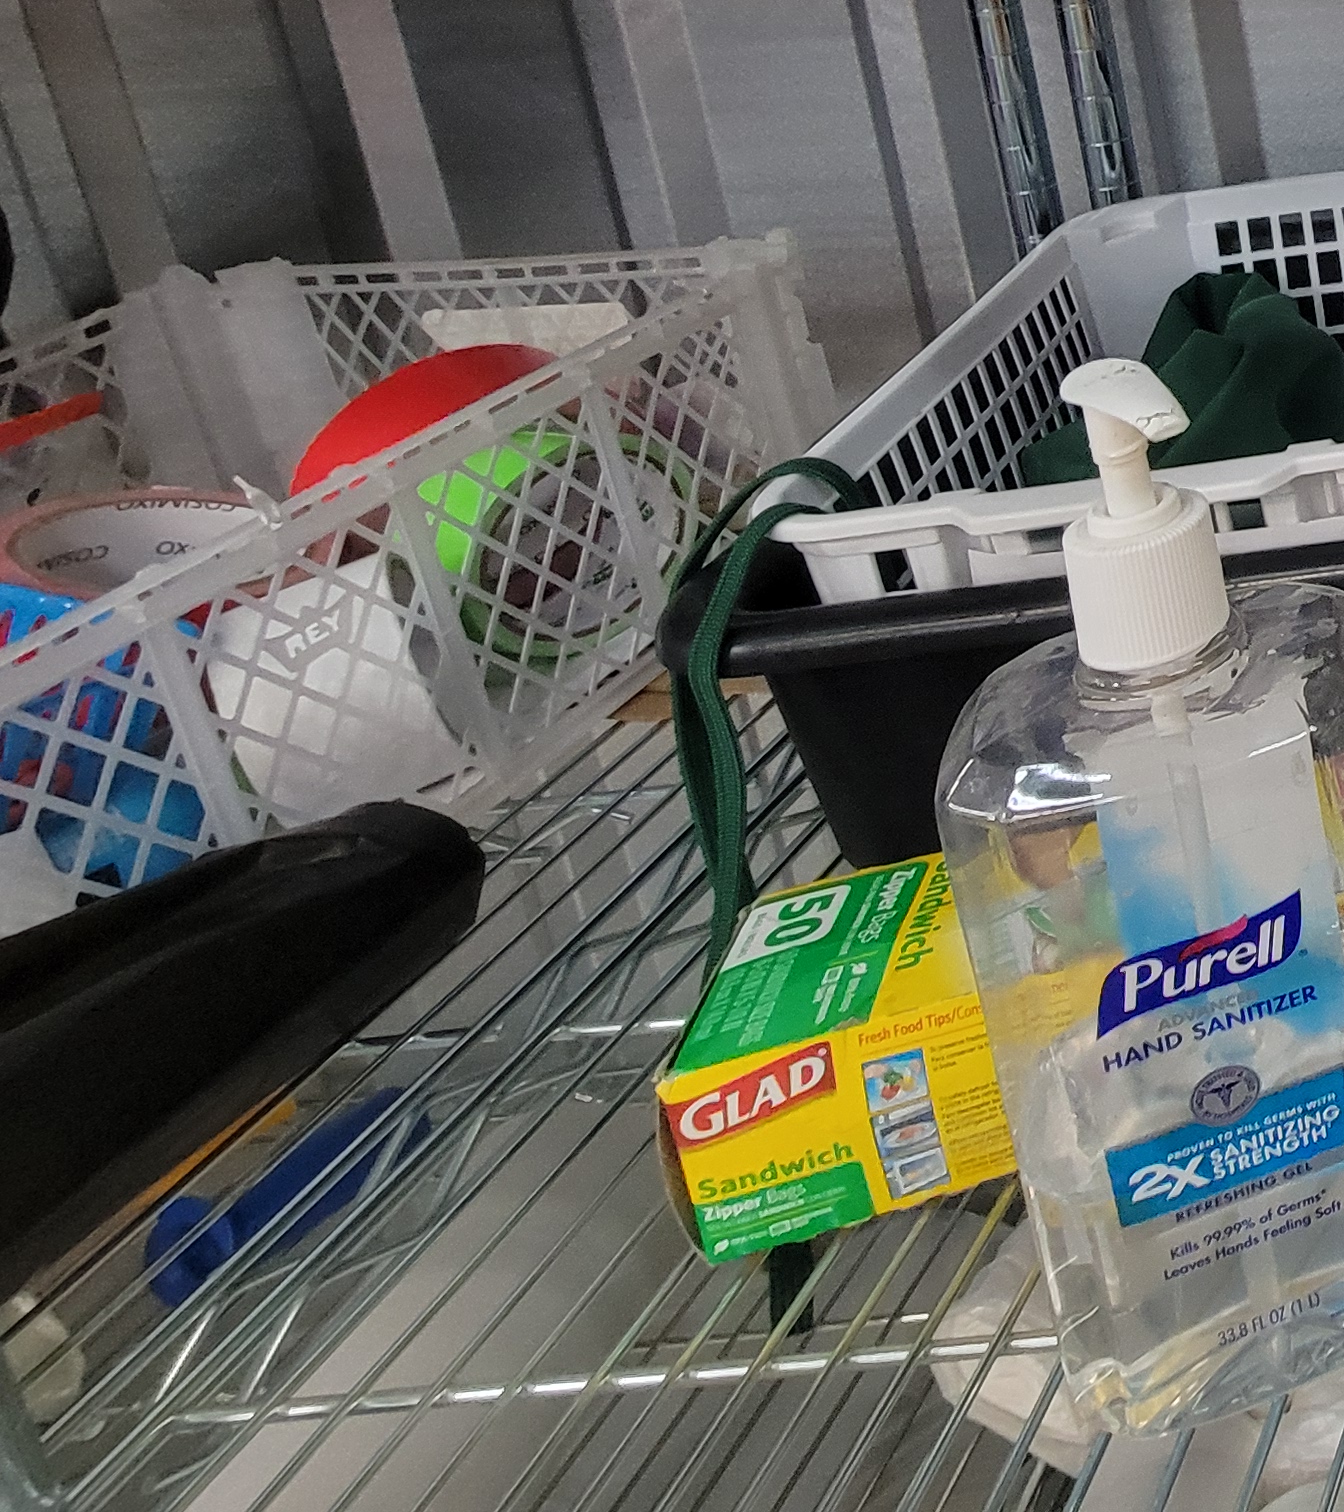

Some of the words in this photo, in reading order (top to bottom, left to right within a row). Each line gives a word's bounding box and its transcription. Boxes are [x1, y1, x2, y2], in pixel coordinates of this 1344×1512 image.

[1120, 915, 1286, 1012] Purell
[1102, 1032, 1183, 1072] HAND
[1192, 986, 1318, 1040] SANITIZER
[680, 1057, 826, 1141] GLAD
[1210, 1104, 1341, 1165] SANITIZING
[1213, 1127, 1327, 1180] STRENGTH
[698, 1142, 854, 1199] Sandwich
[1129, 1155, 1212, 1204] 2X
[1170, 1240, 1199, 1260] Kills
[1260, 1210, 1273, 1224] of
